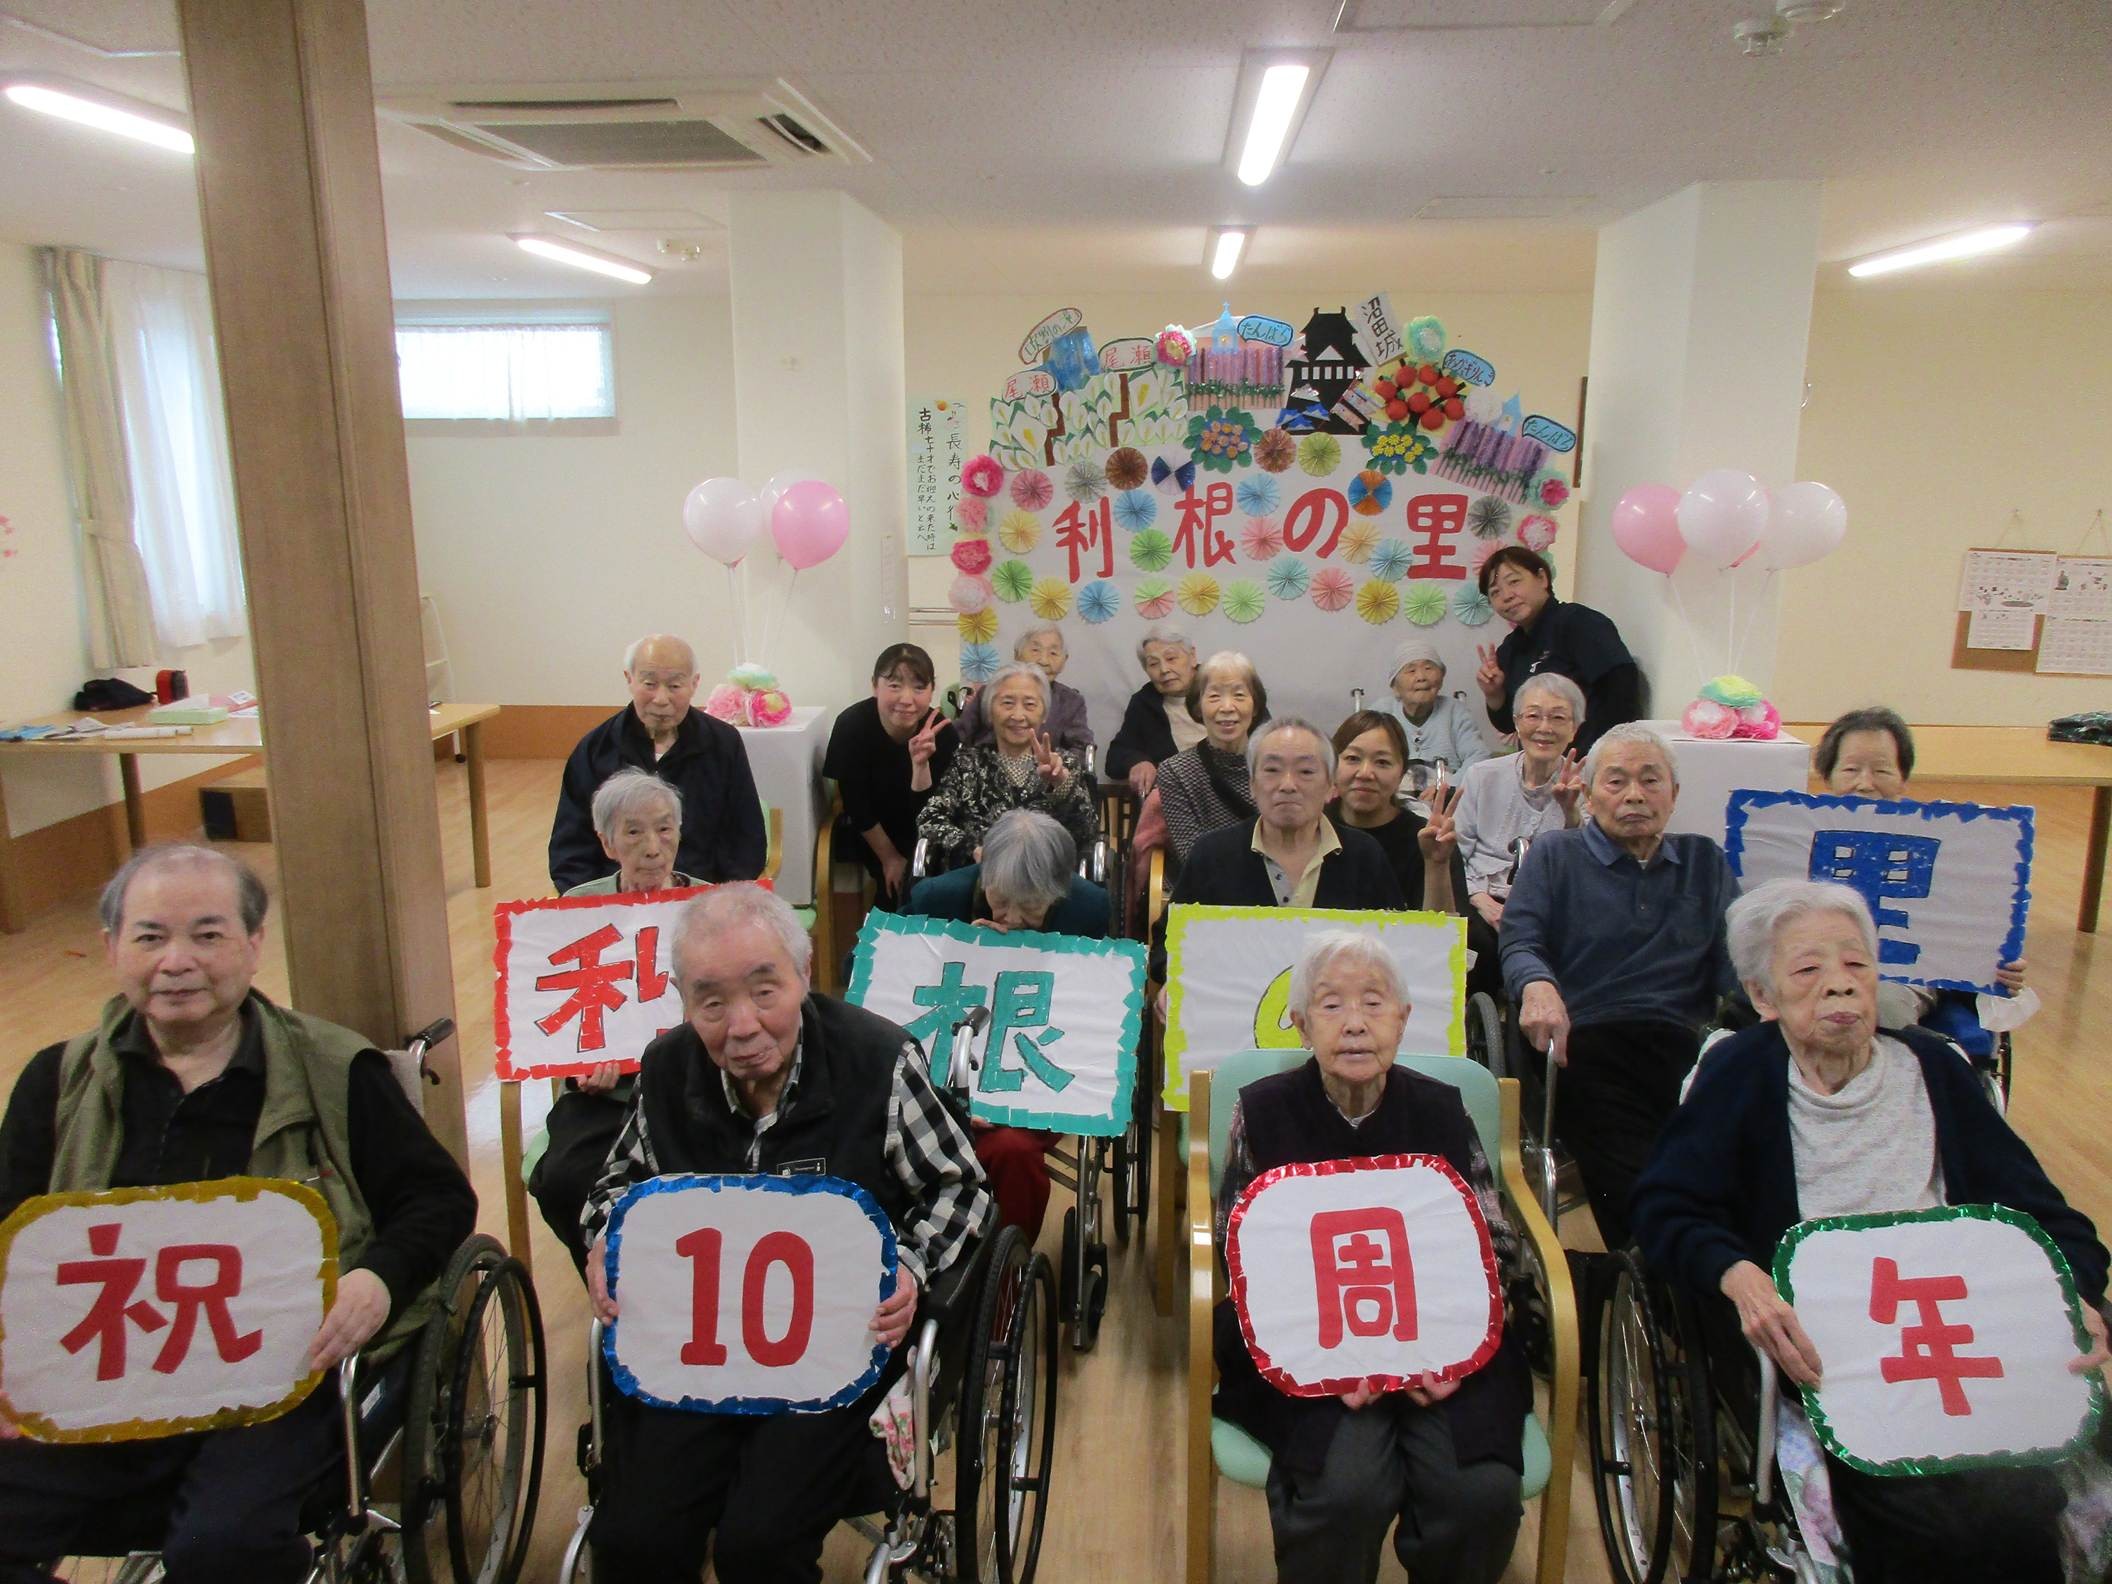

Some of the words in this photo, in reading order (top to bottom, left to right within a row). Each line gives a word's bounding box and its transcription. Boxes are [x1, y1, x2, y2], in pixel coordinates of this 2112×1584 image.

[1004, 373, 1050, 399] 尾瀬
[1240, 322, 1290, 344] たんばら
[1361, 296, 1403, 360] 沼田城
[1052, 481, 1470, 584] 利根の里
[901, 961, 1076, 1093] 根
[57, 1222, 264, 1382] 祝
[675, 1227, 815, 1368] 10
[1309, 1206, 1419, 1350] 周
[1869, 1256, 2004, 1417] 年
